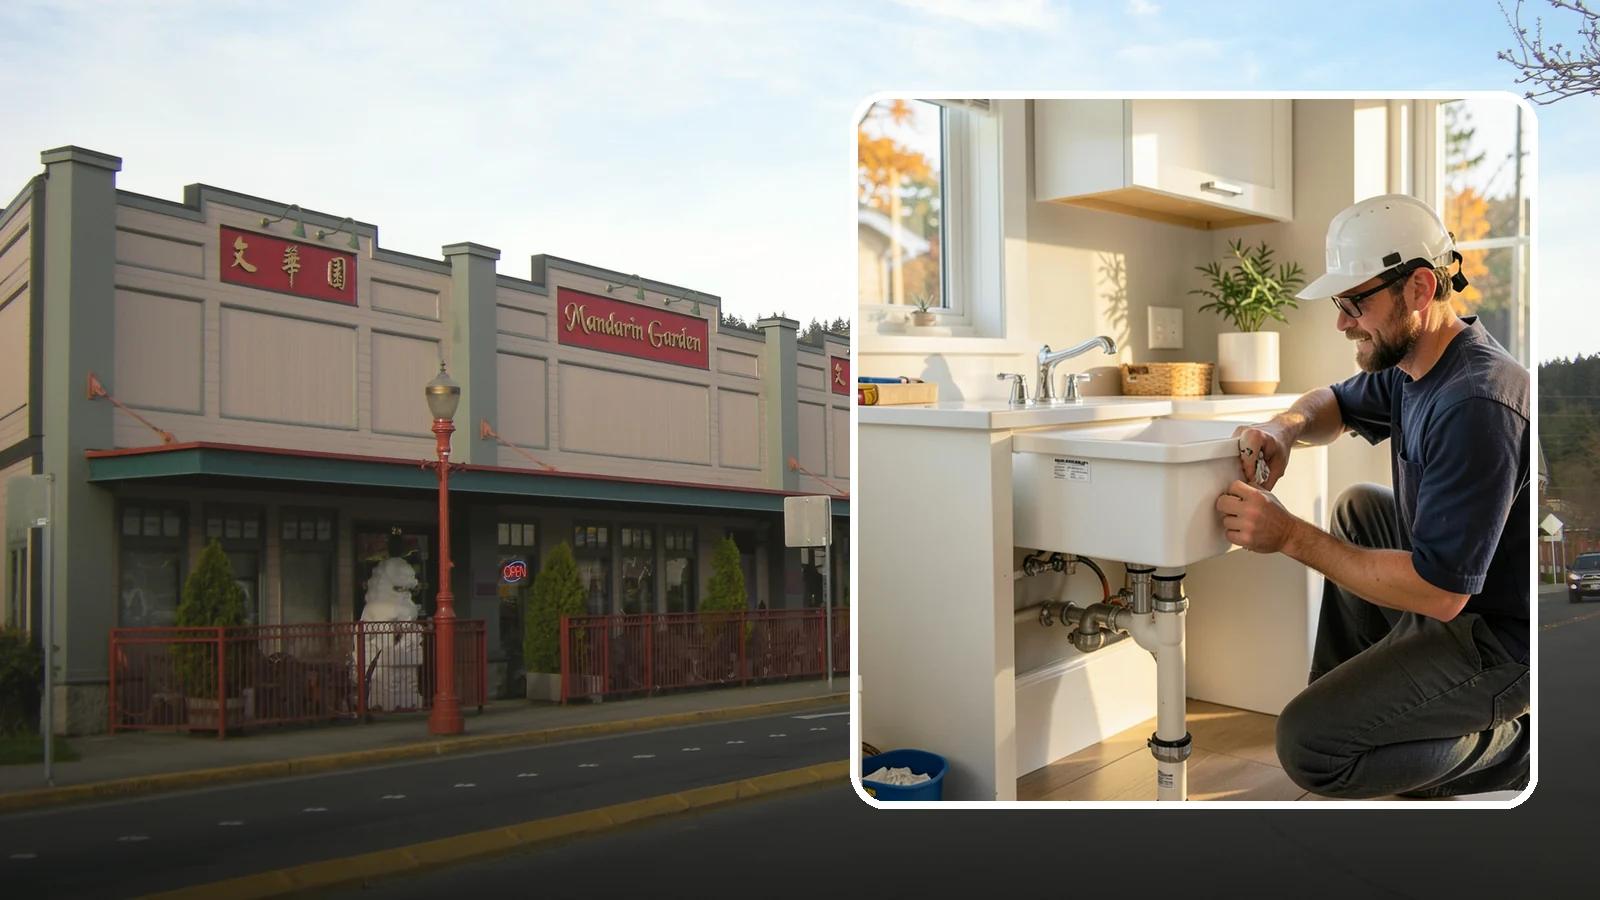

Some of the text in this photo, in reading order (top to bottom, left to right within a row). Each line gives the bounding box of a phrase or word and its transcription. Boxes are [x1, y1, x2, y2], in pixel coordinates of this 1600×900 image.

[564, 302, 701, 352] Mandarin Garden
[503, 565, 527, 578] OPEN
